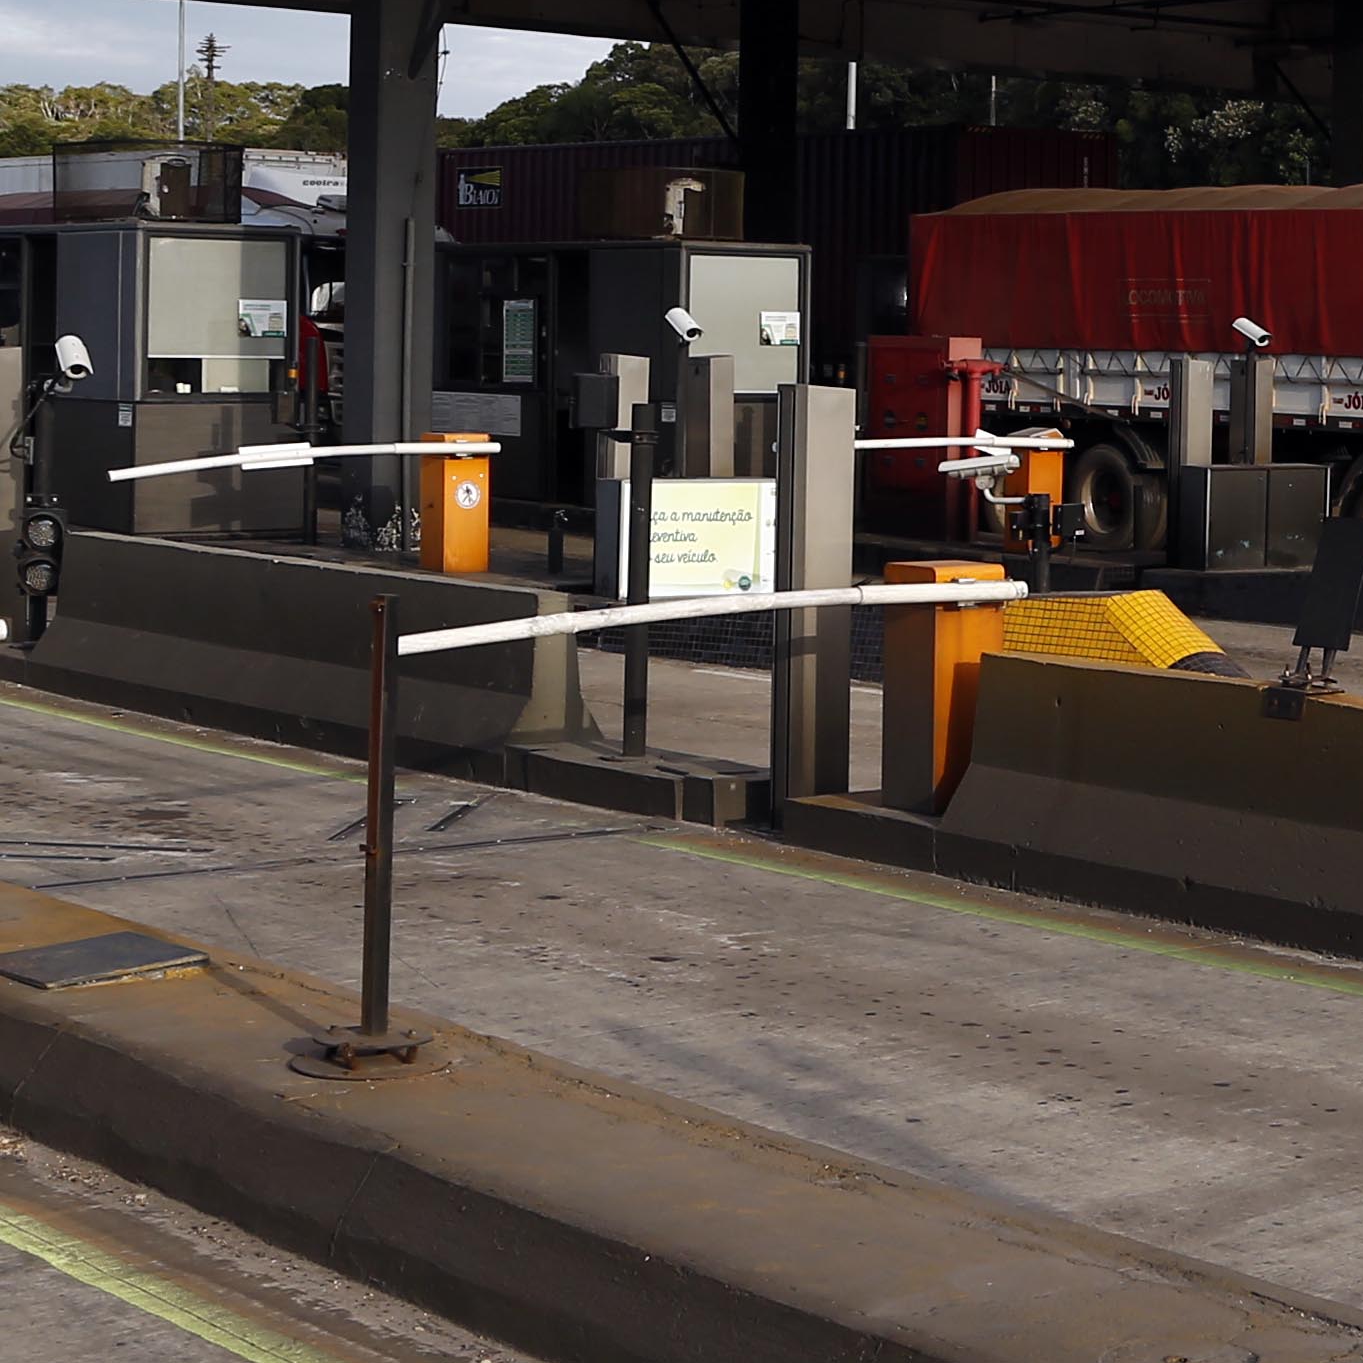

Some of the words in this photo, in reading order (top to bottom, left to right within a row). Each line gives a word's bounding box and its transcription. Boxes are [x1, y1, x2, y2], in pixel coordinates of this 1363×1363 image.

[670, 510, 680, 522] a
[682, 507, 753, 526] manutenção
[654, 550, 676, 564] seu
